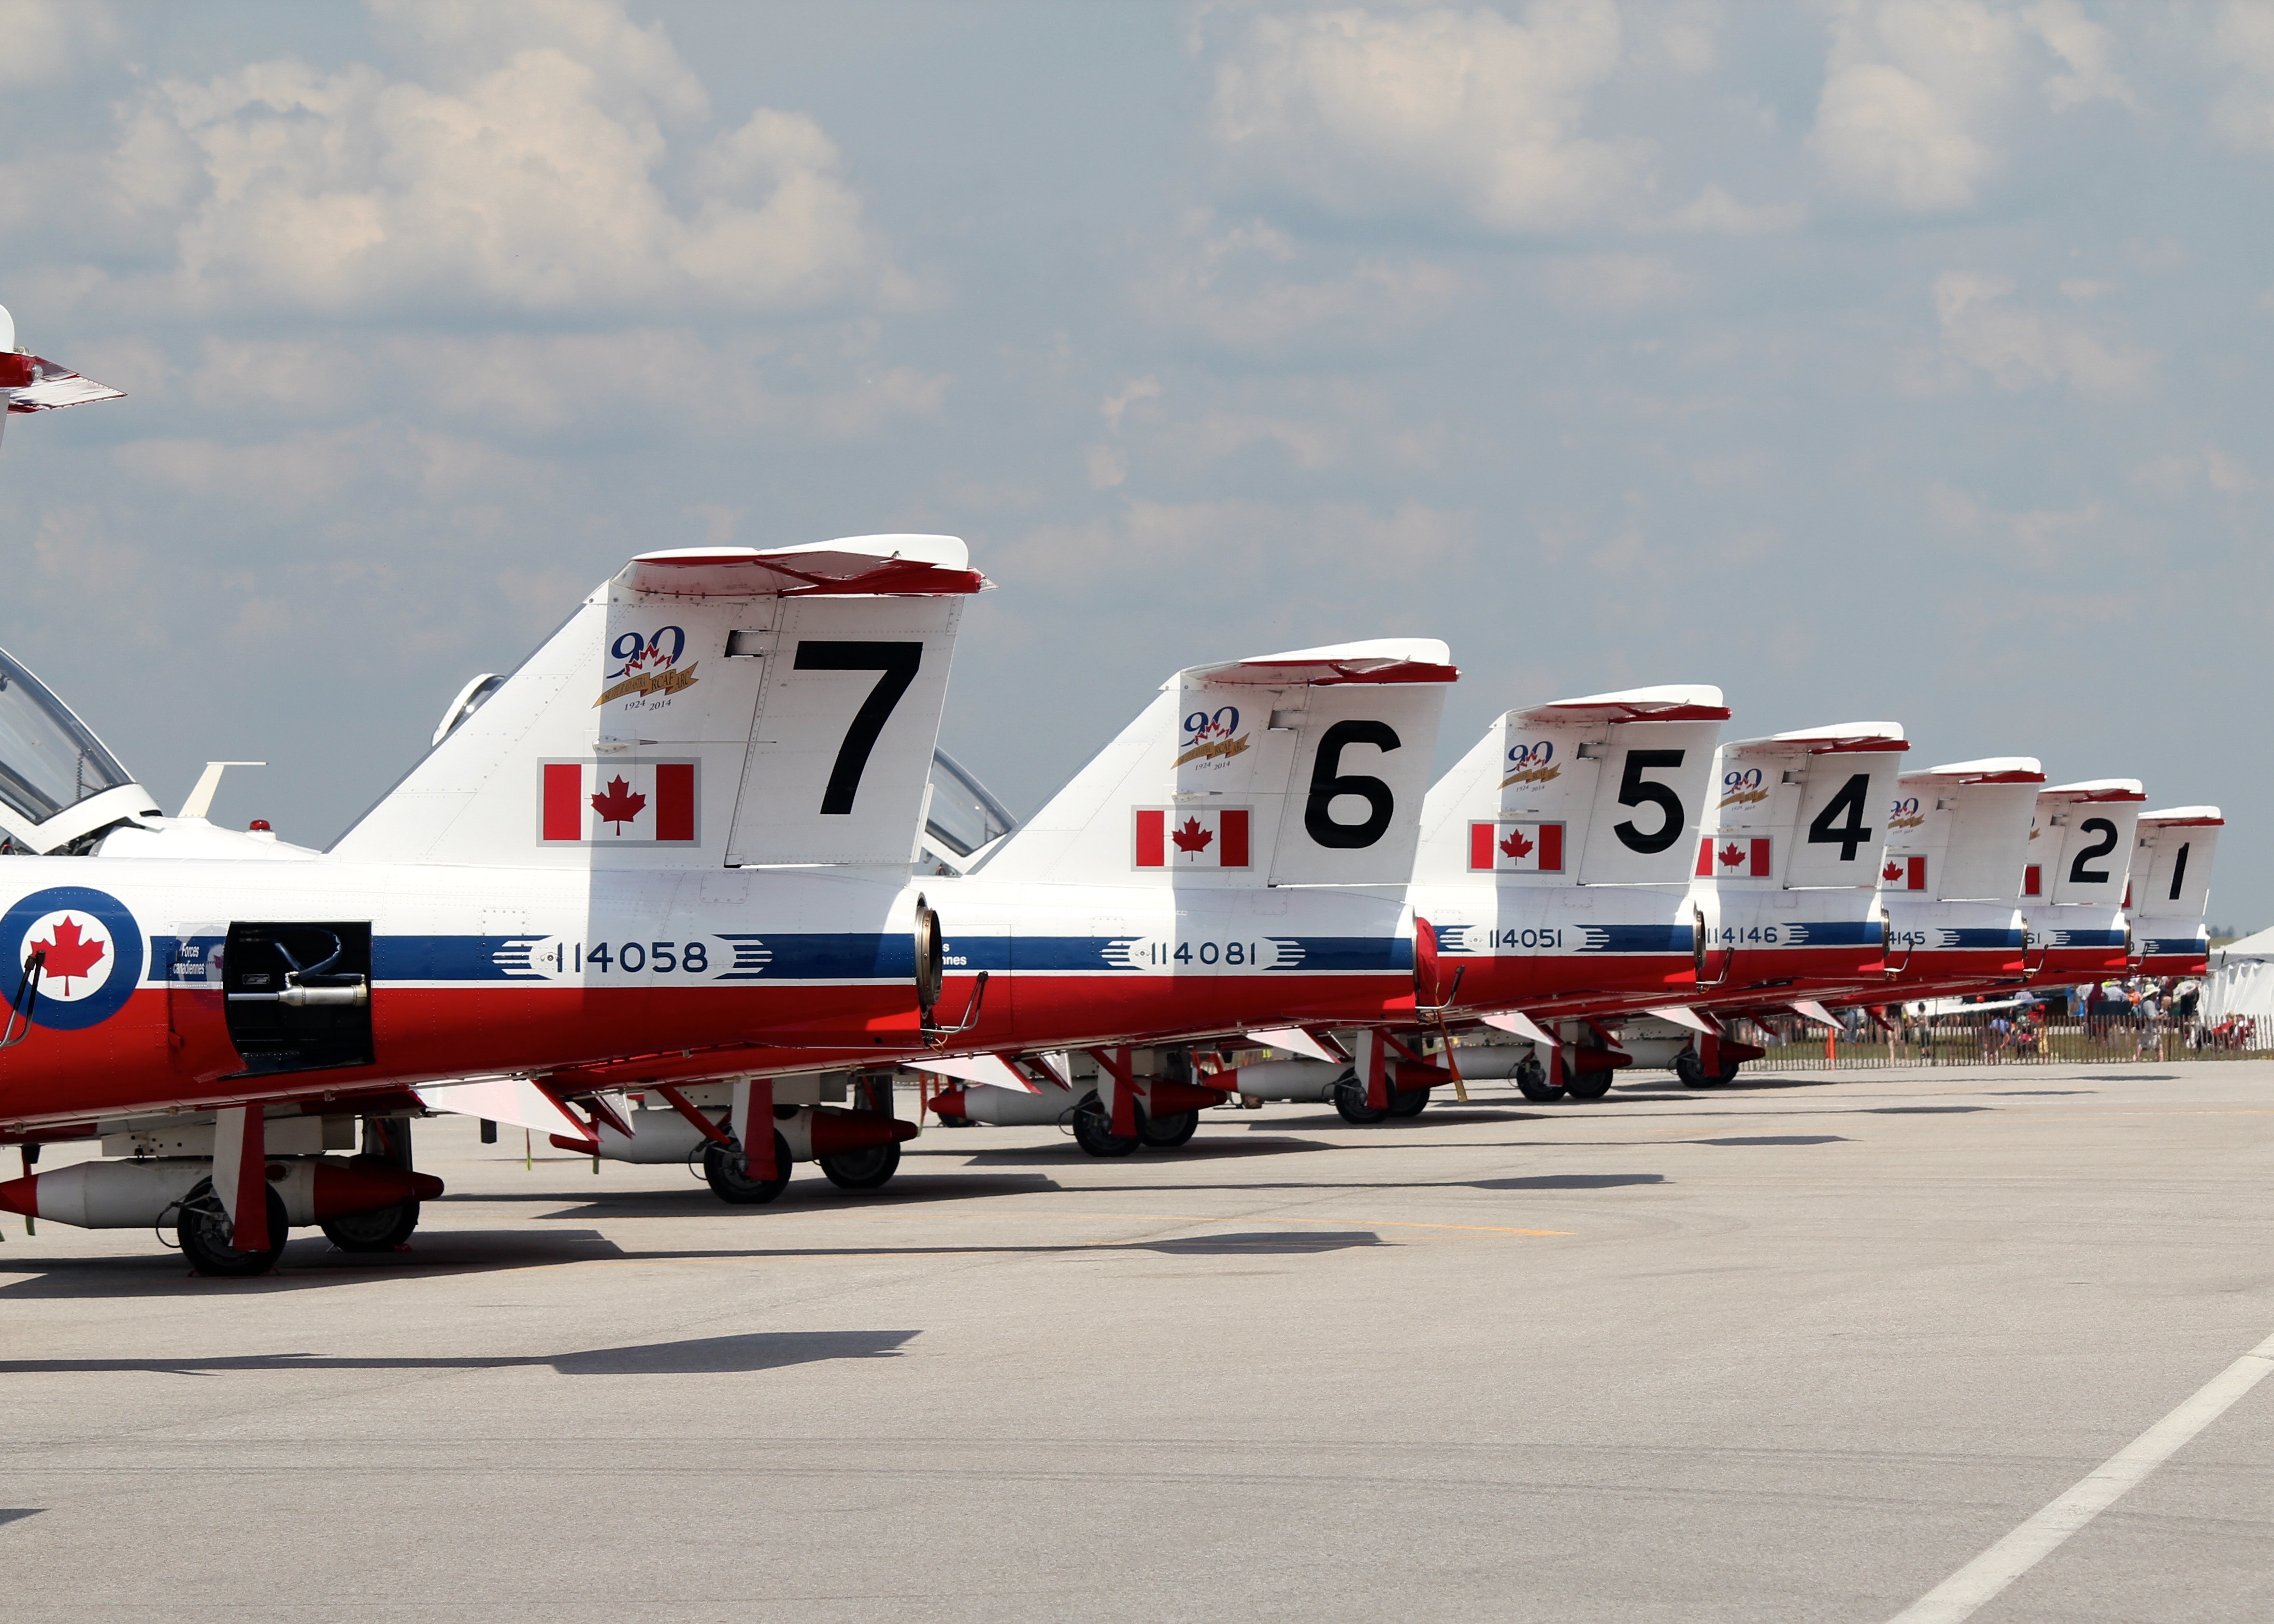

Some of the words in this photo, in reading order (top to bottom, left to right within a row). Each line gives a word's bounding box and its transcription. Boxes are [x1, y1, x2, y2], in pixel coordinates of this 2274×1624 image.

[607, 625, 685, 679] 90
[651, 671, 674, 691] RCAF
[675, 671, 690, 690] ARC
[624, 699, 646, 711] 1924
[649, 699, 671, 711] 2014
[793, 640, 923, 815] 7
[1181, 706, 1239, 747] 90
[1215, 741, 1232, 755] RCAF
[1505, 741, 1554, 773] 90
[1195, 761, 1211, 771] 1924
[1213, 760, 1231, 770] 2014
[1304, 720, 1401, 849] 6
[1722, 768, 1762, 795] 90
[1613, 749, 1685, 854] 5
[1808, 773, 1872, 861] 4
[2069, 817, 2118, 883] 2
[2169, 842, 2190, 900] 1
[1489, 929, 1562, 948] 114051
[1707, 926, 1778, 944] 114146
[181, 942, 200, 958] Forces
[556, 942, 708, 973] 114058
[1151, 942, 1256, 965] 114081
[173, 960, 205, 975] canadiennes
